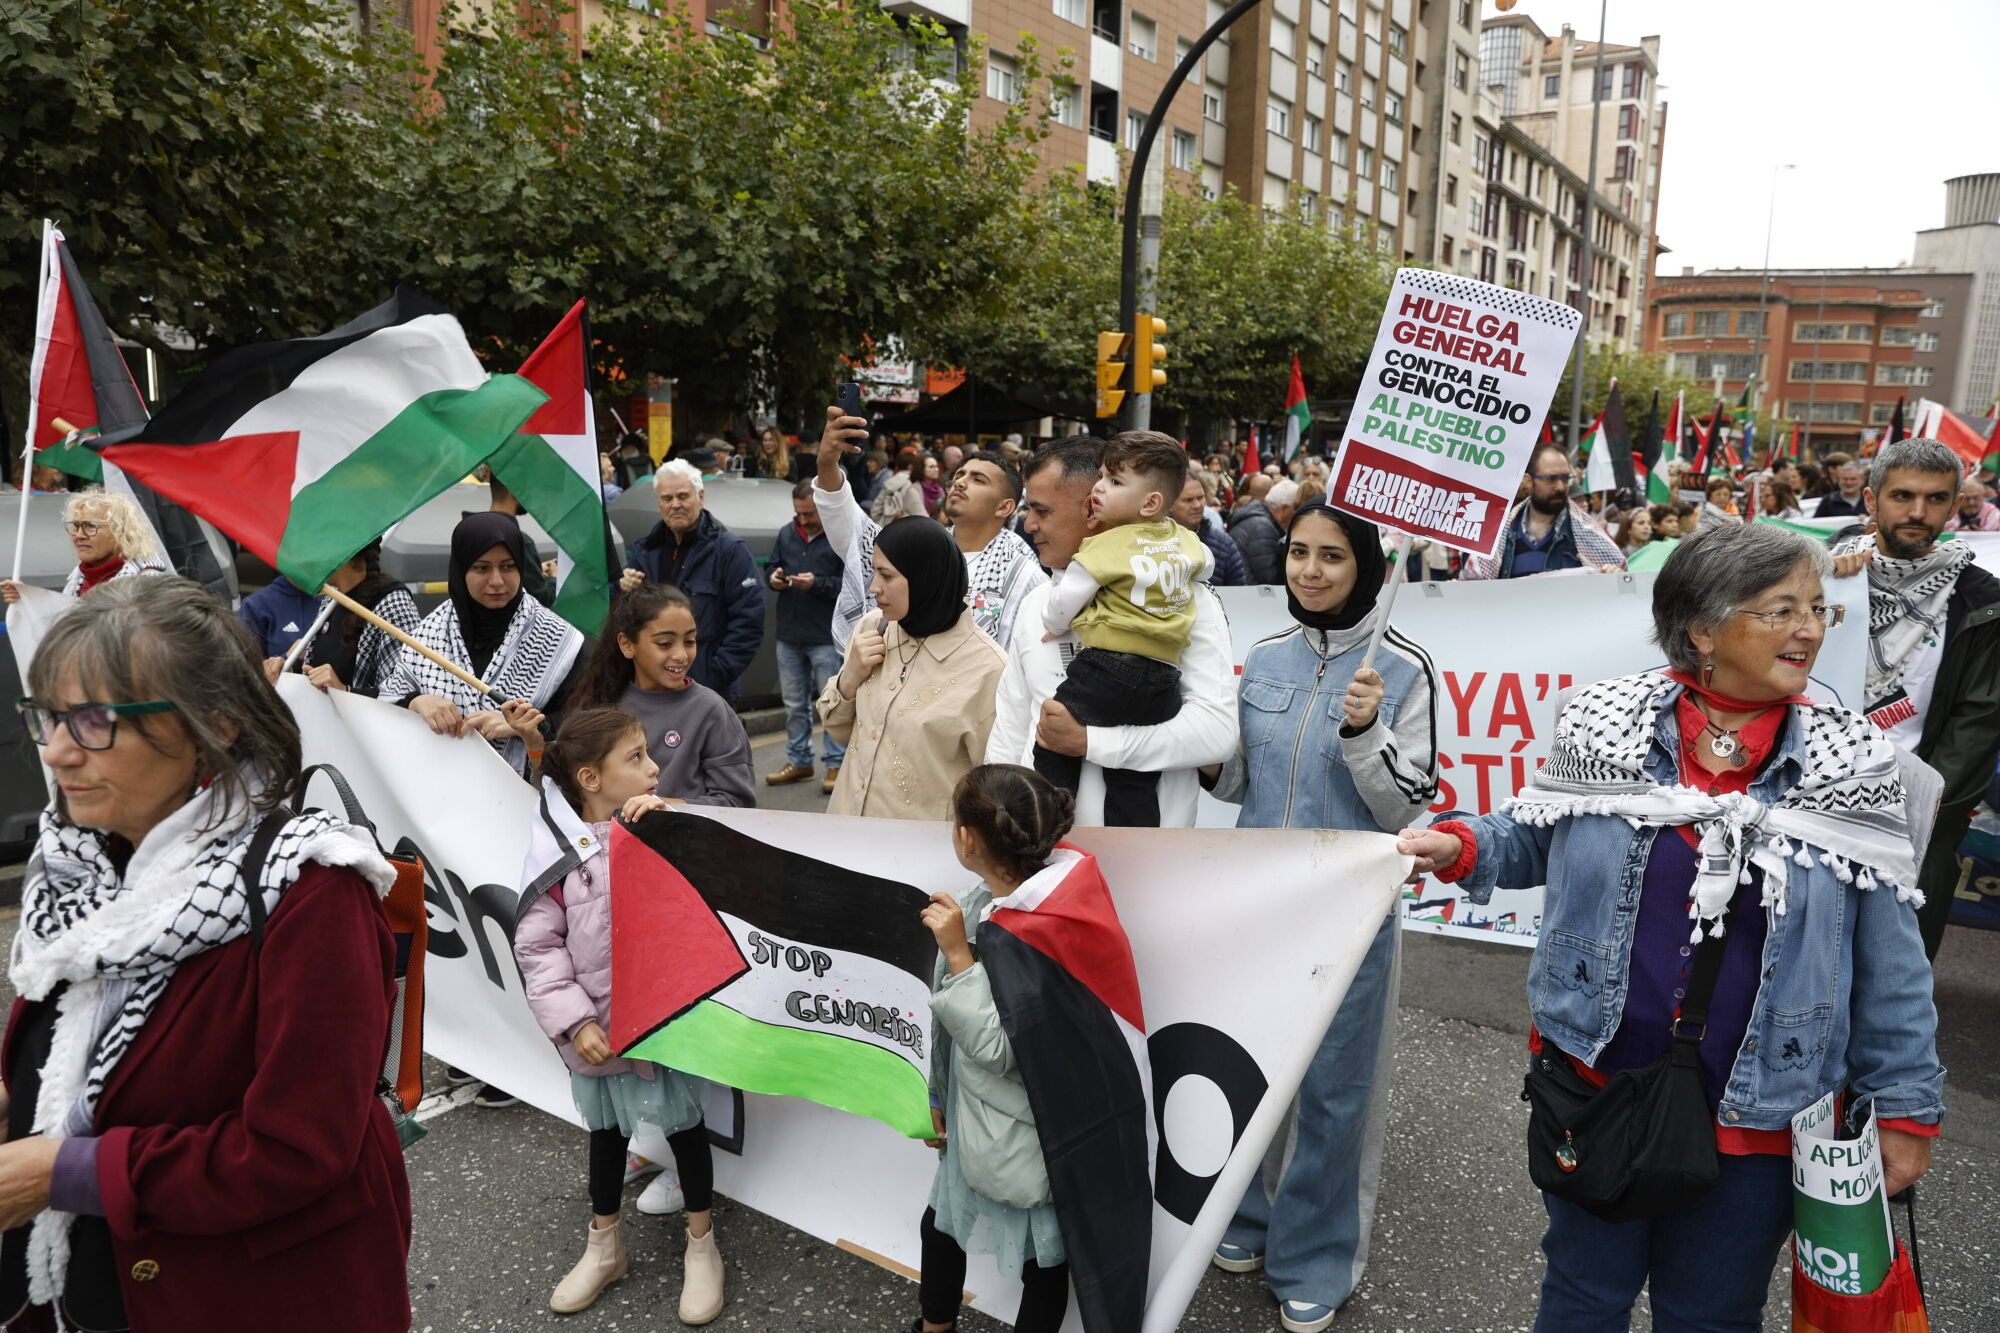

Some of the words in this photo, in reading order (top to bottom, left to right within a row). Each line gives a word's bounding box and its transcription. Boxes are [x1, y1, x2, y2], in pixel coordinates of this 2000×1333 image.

[1399, 294, 1519, 346] HUELGA
[1384, 349, 1472, 387] CONTRA
[1478, 374, 1502, 394] EL
[1392, 320, 1527, 377] GENERAL
[1368, 393, 1402, 418] AL
[1405, 402, 1506, 445] PUEBLO
[1378, 367, 1532, 424] GENOCIDIO
[1362, 415, 1505, 470] PALESTINO
[1343, 485, 1483, 543] REVOLUCIONARIA
[1349, 463, 1462, 517] IZQUIERDA
[1866, 697, 1919, 732] RBARIE
[748, 931, 832, 977] STOP
[1795, 1229, 1861, 1280] NO!
